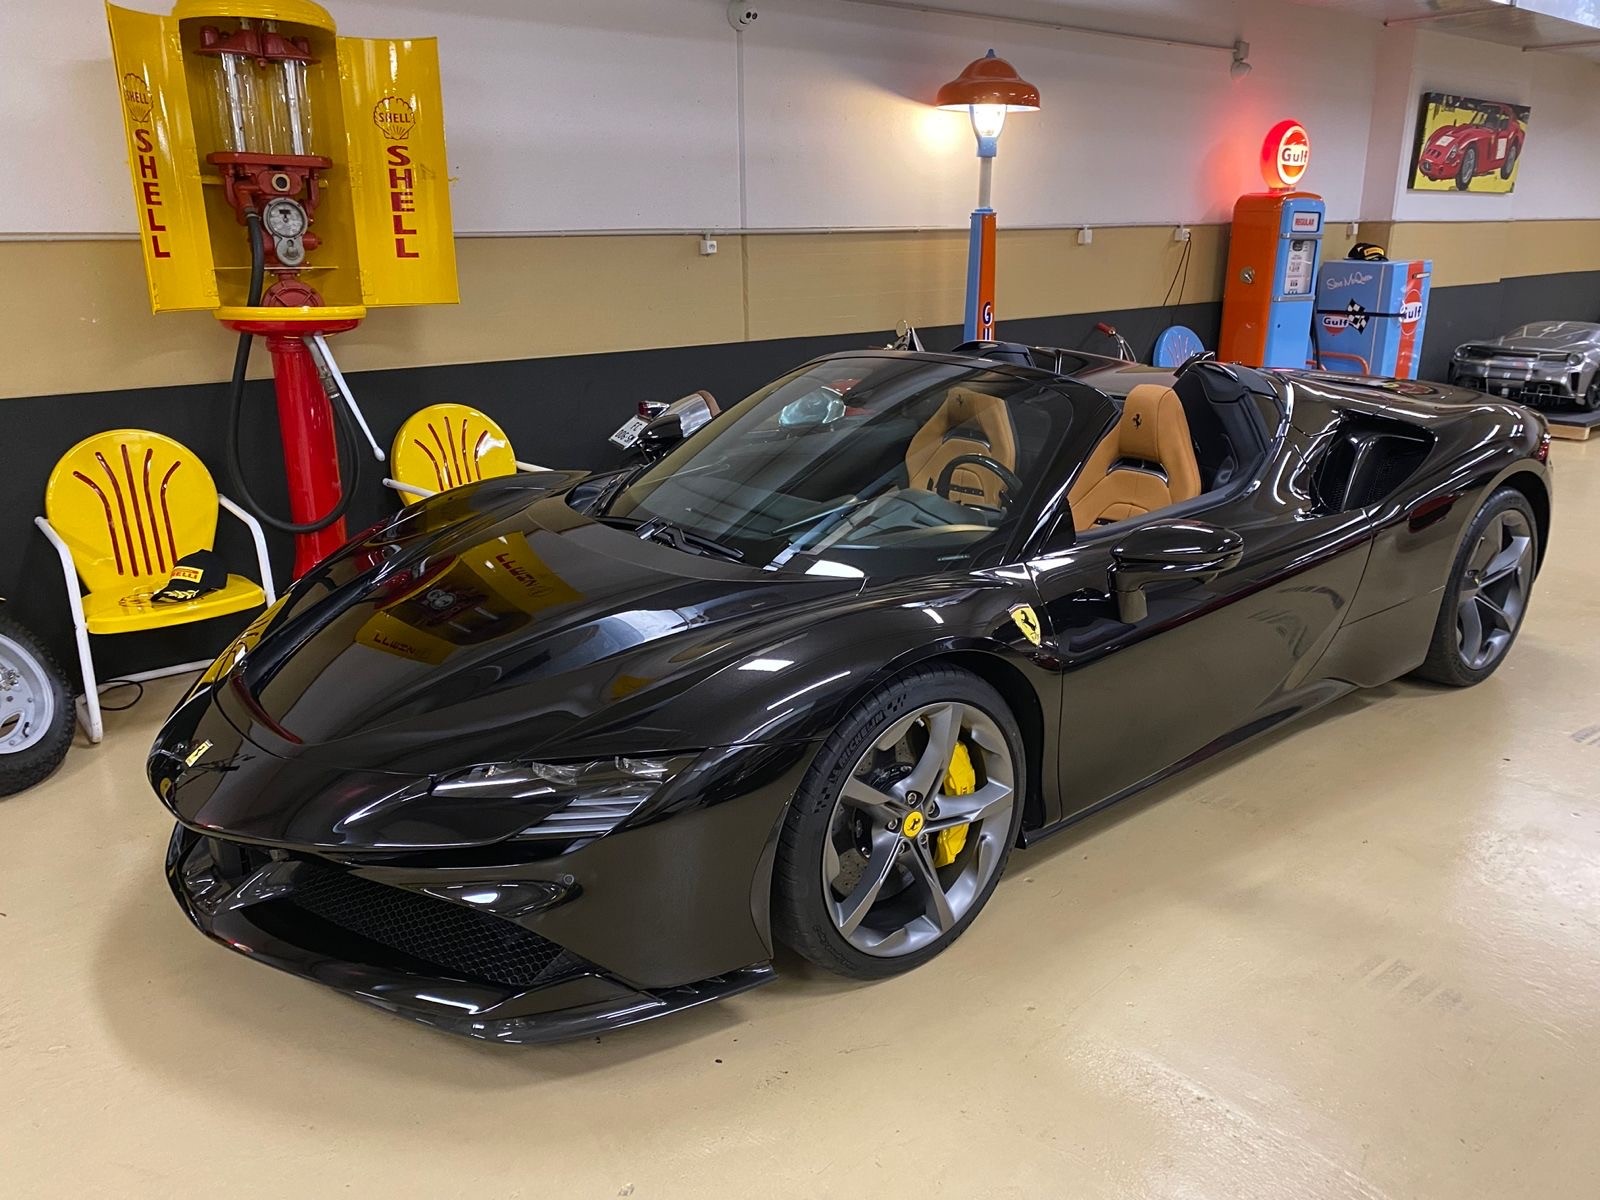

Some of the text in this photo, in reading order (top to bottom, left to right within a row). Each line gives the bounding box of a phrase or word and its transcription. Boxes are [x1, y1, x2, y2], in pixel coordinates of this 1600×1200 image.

[378, 112, 411, 123] SHELL
[1281, 147, 1308, 163] Gulf
[134, 128, 171, 258] SHELL
[386, 145, 420, 258] SHELL
[1295, 218, 1315, 226] REGULAR
[1323, 317, 1348, 326] Gulf
[838, 709, 887, 769] MICHELIN
